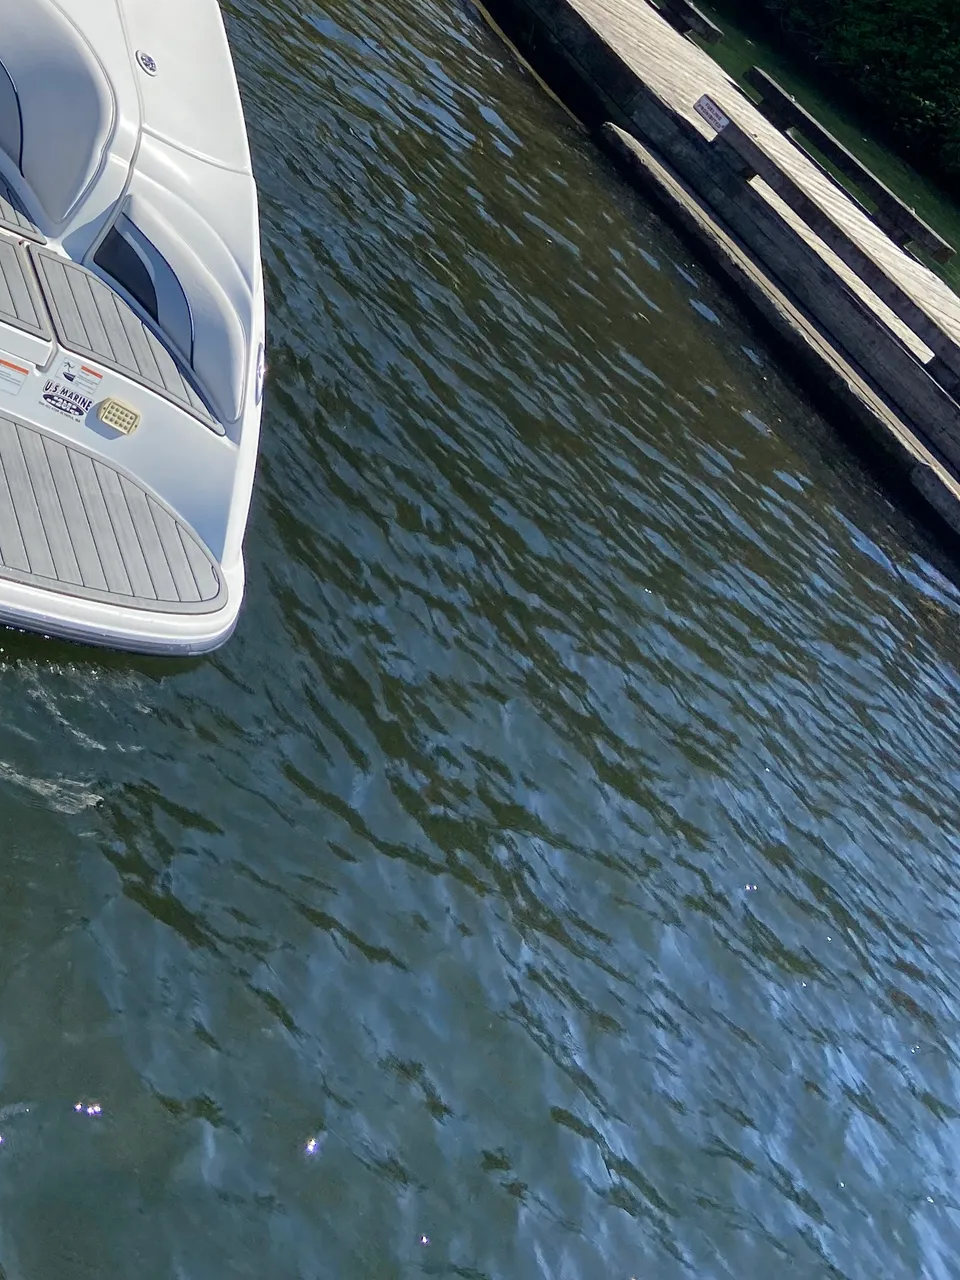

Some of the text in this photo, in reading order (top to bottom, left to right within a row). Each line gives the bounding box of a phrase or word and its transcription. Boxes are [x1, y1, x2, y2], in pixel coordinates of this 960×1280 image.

[697, 103, 722, 129] PROHIBITED
[705, 102, 722, 120] FUELING
[60, 388, 92, 411] MARINE
